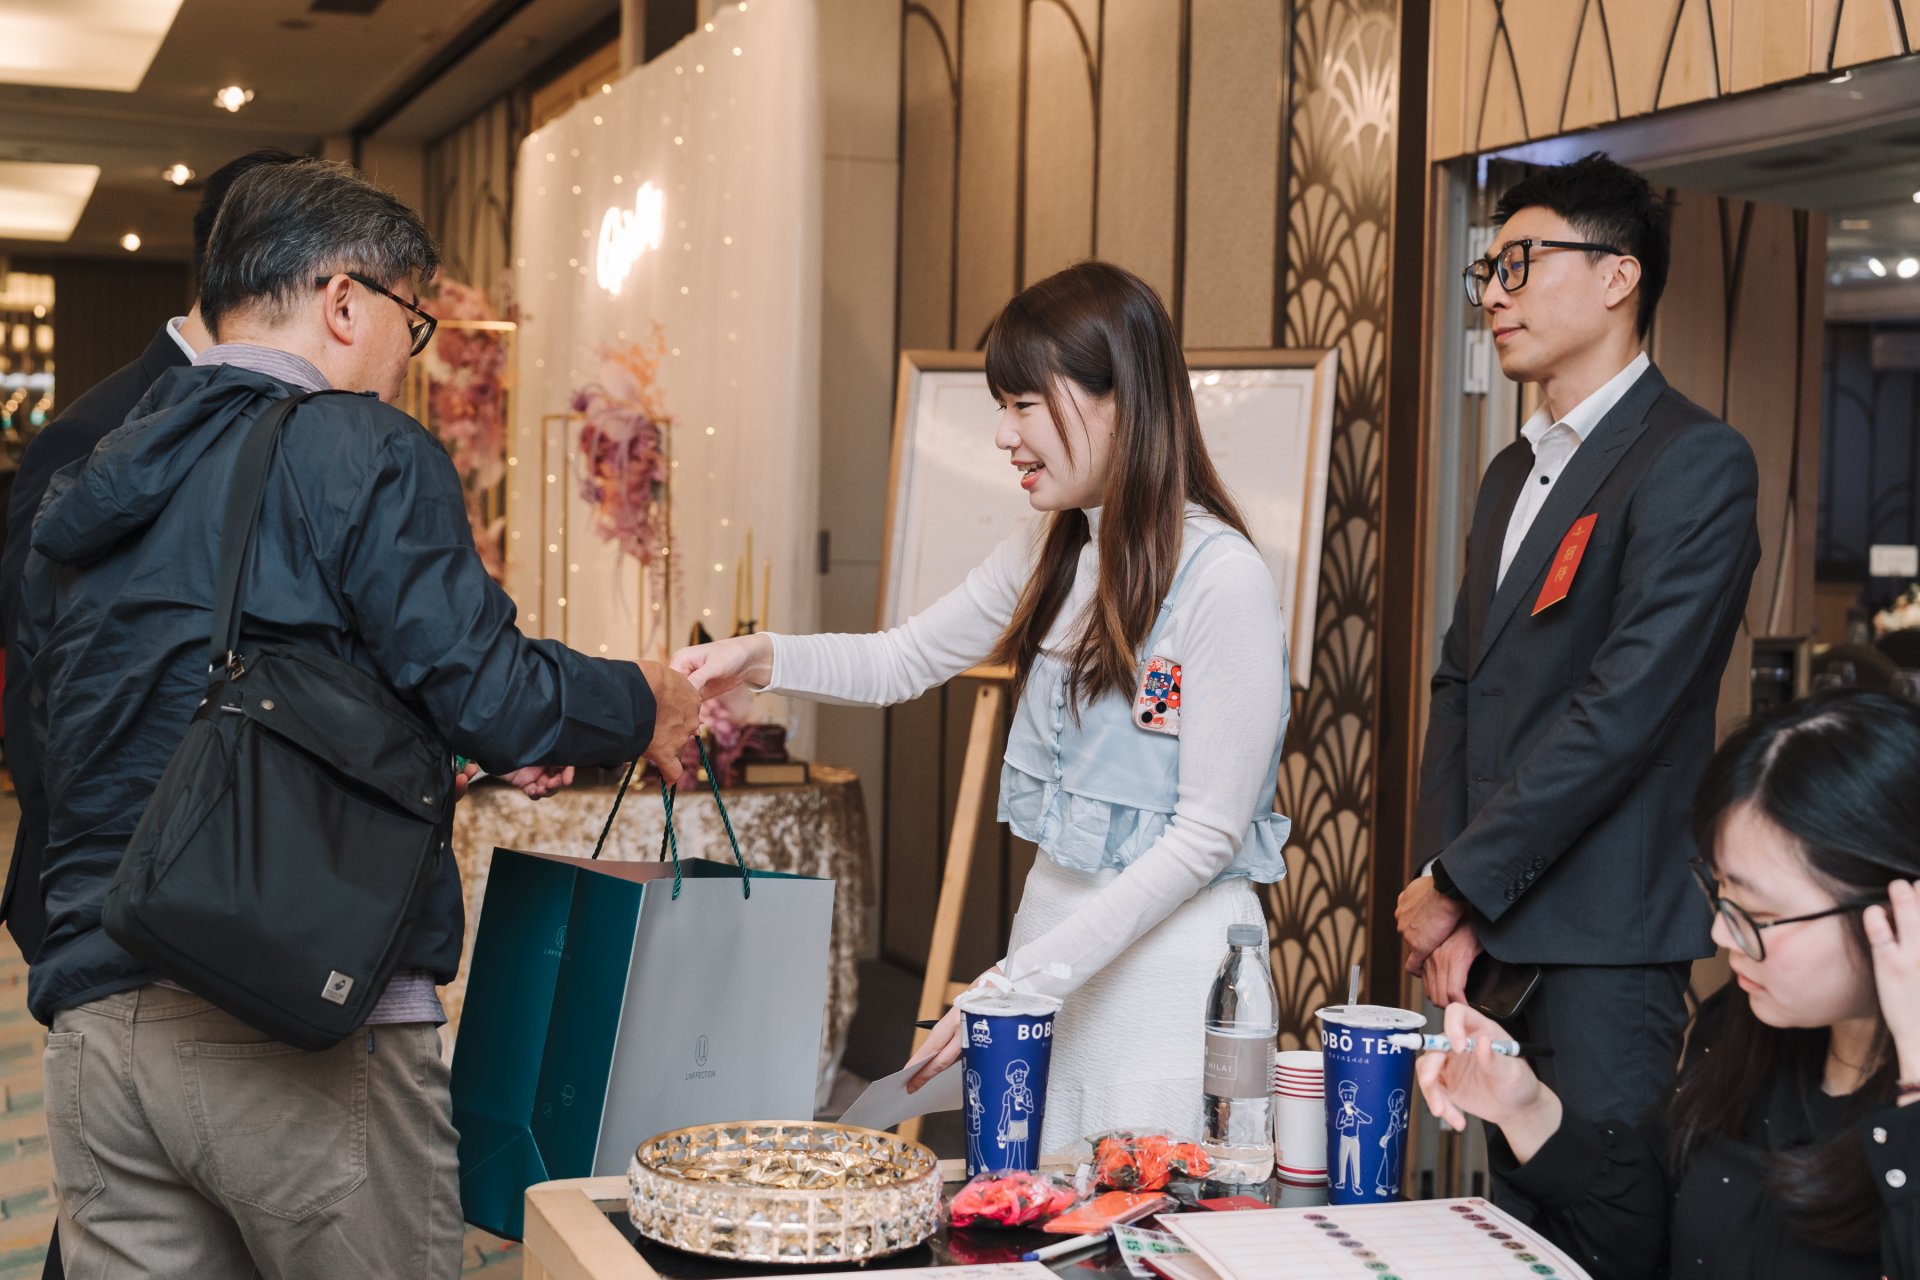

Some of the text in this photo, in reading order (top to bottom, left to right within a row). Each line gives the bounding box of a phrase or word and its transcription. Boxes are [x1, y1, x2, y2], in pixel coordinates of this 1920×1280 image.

[1017, 1021, 1054, 1040] BOB
[1322, 1029, 1402, 1055] OBŌ TEA
